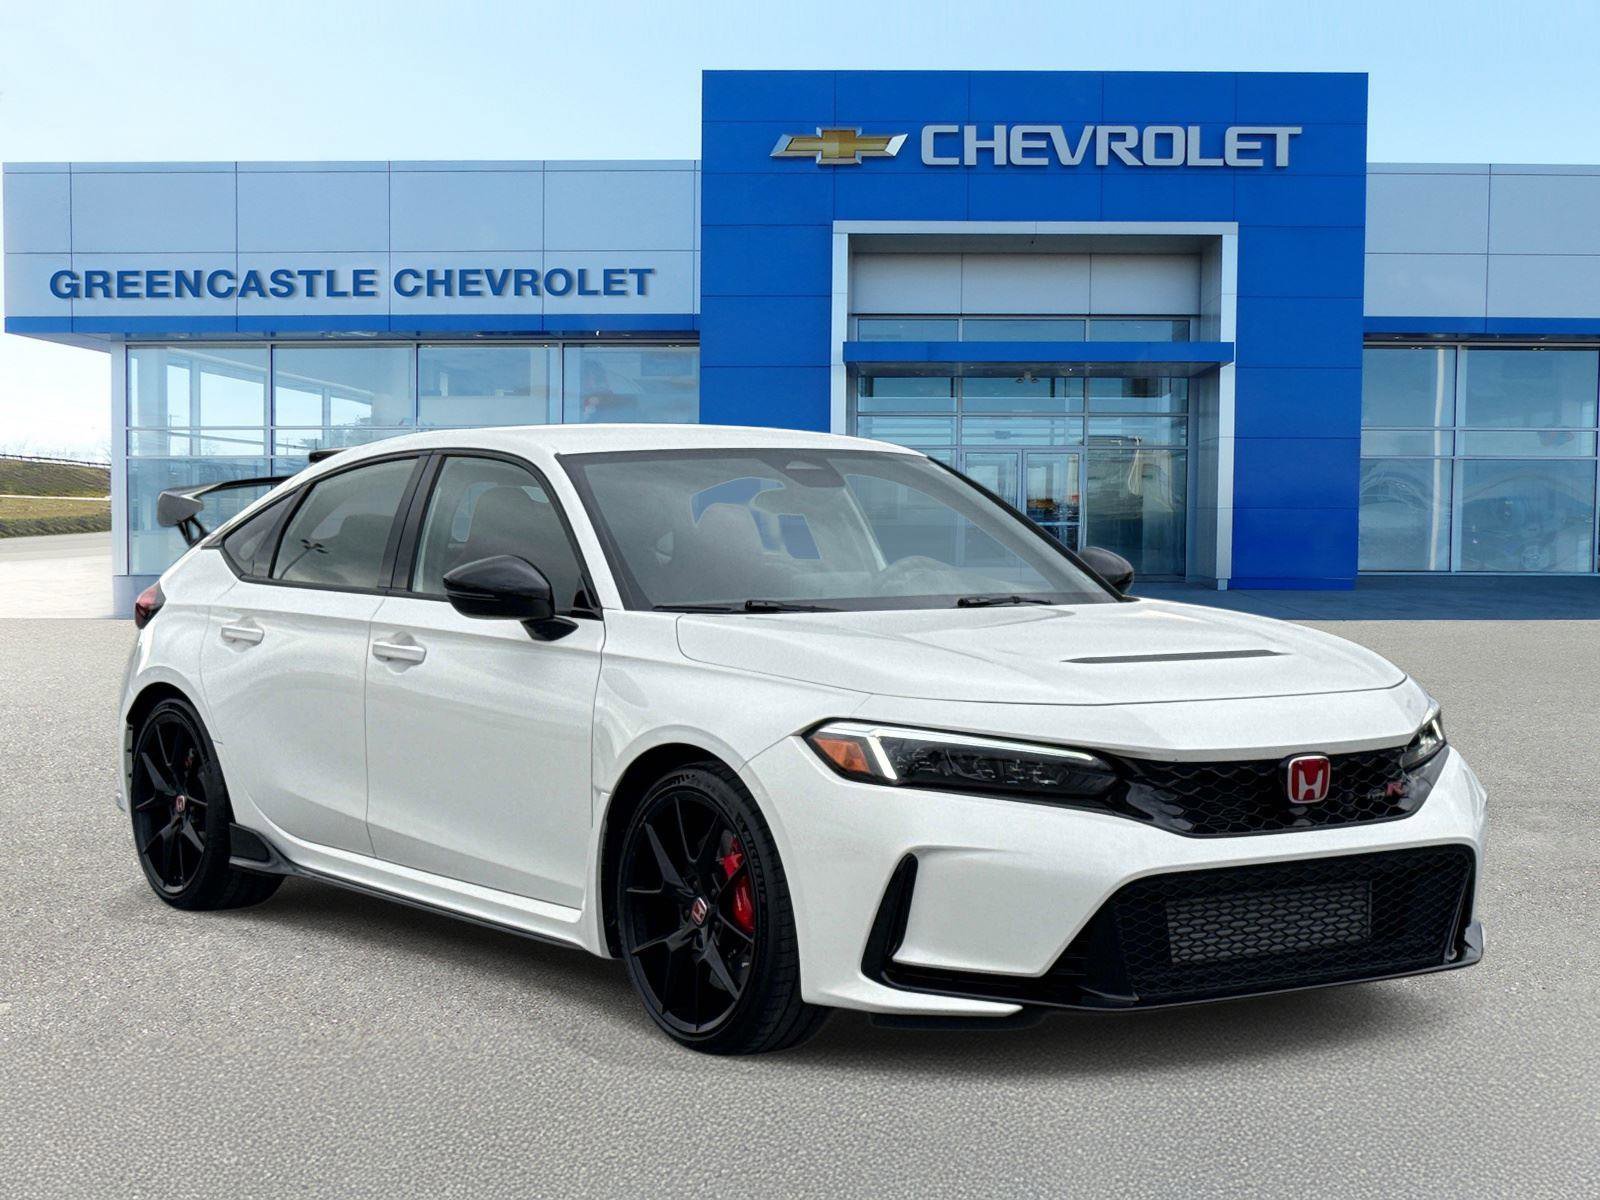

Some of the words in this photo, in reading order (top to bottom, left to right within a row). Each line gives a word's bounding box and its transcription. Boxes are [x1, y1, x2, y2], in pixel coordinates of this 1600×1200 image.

[921, 125, 1302, 167] CHEVROLET
[49, 269, 377, 299] GREENCASTLE
[393, 268, 655, 298] CHEVROLET
